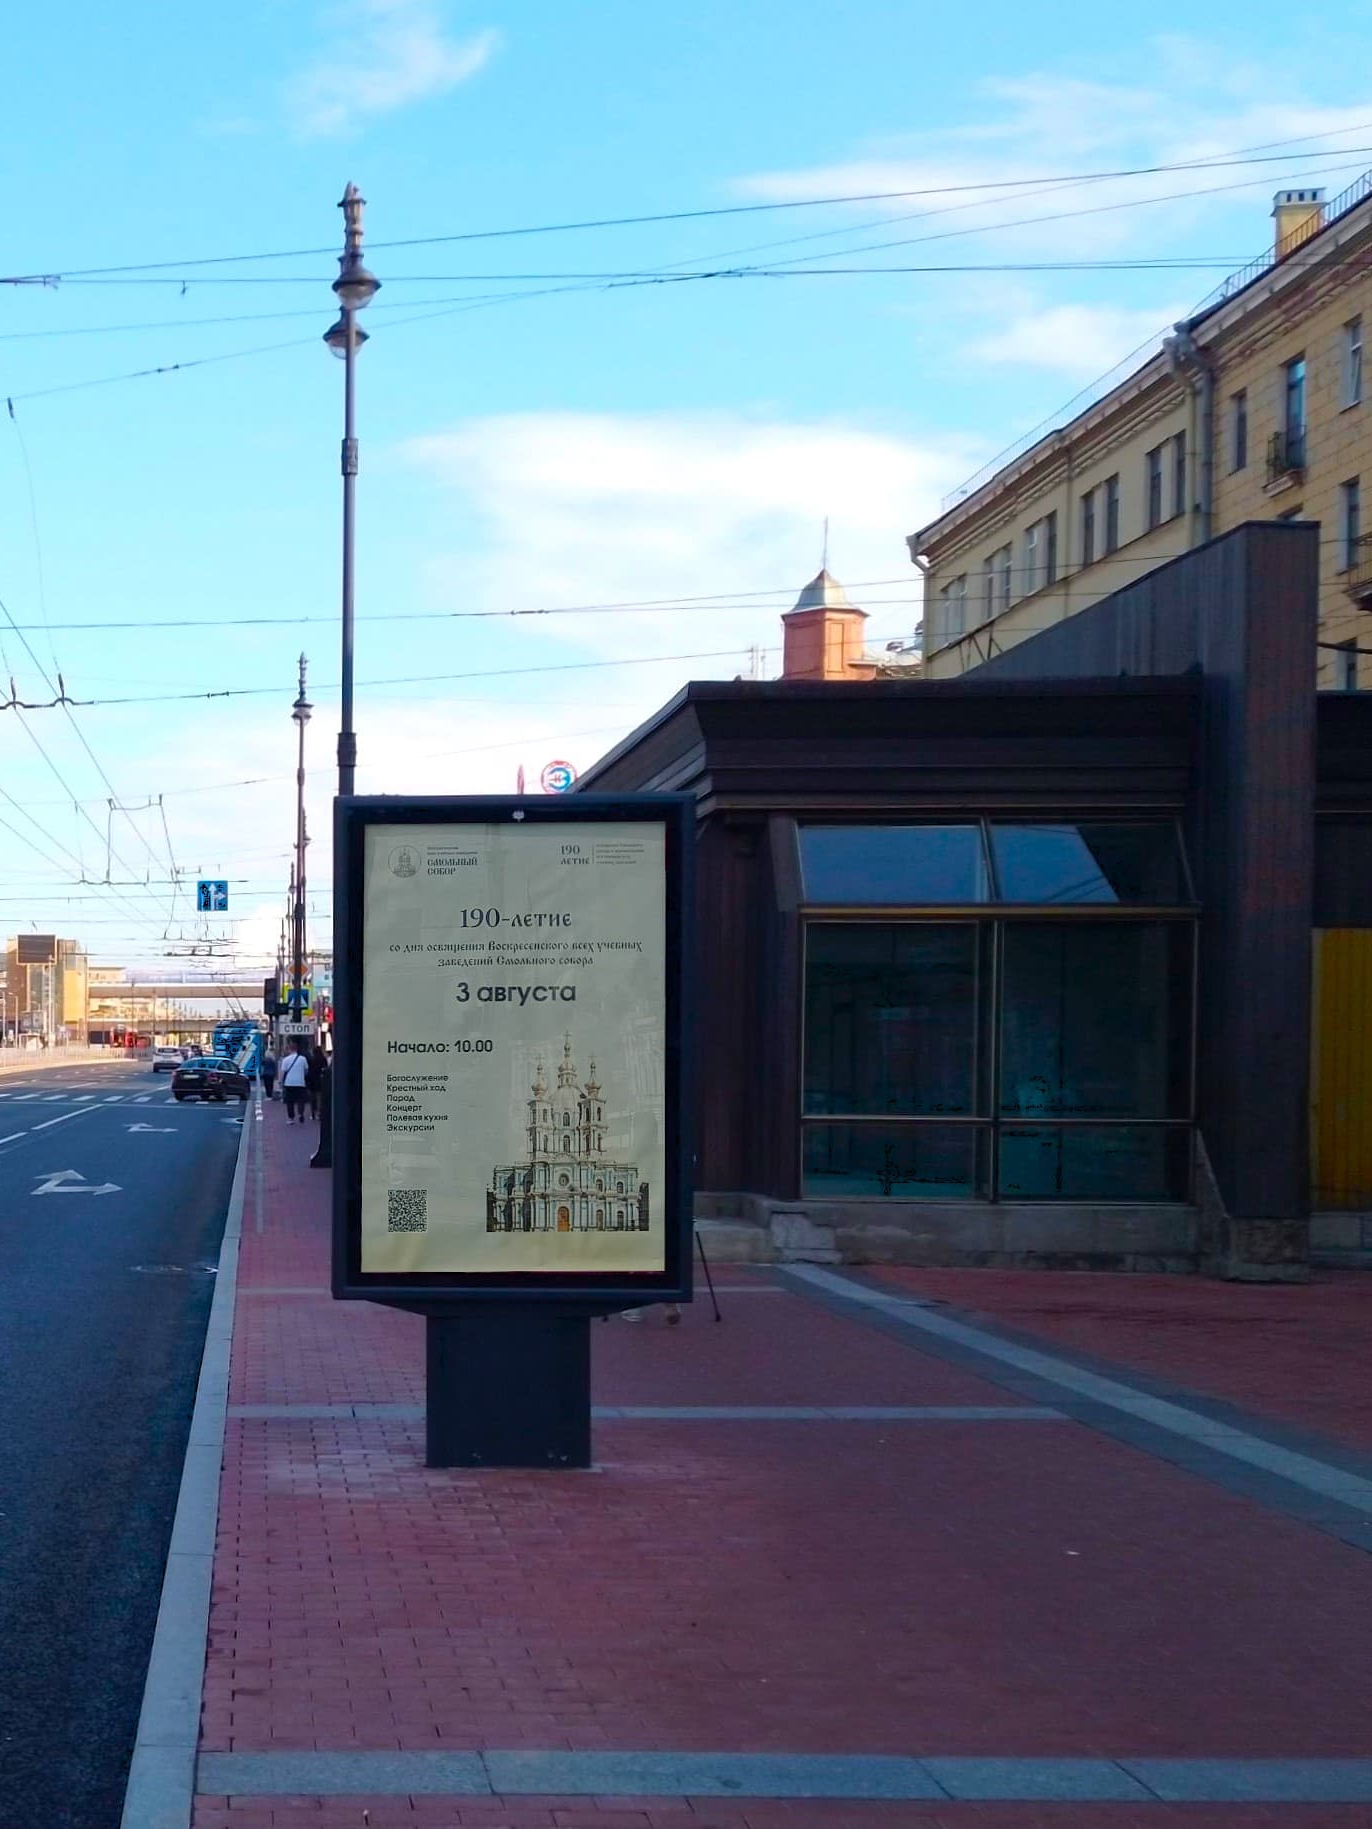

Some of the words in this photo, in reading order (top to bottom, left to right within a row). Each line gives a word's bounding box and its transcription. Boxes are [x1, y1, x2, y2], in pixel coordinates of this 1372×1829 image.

[560, 844, 580, 855] 190
[427, 867, 456, 875] СОБОР
[389, 944, 401, 952] со
[403, 944, 424, 953] дня
[488, 940, 569, 953] Воскресенского
[572, 942, 594, 952] всех
[597, 941, 642, 952] учебных
[437, 957, 493, 967] заведений
[496, 956, 556, 966] Смольного
[559, 957, 594, 967] собора
[456, 982, 470, 1002] 3
[477, 985, 576, 1006] августа
[284, 1024, 310, 1032] СТОП
[387, 1040, 450, 1053] Начало:
[454, 1039, 493, 1053] 10.00
[387, 1074, 449, 1083] Богослужение
[387, 1083, 428, 1092] Крестный
[387, 1094, 415, 1102] Парад
[387, 1104, 422, 1112] Концерт
[424, 1114, 448, 1123] кухня
[387, 1124, 435, 1132] Экскурсии
